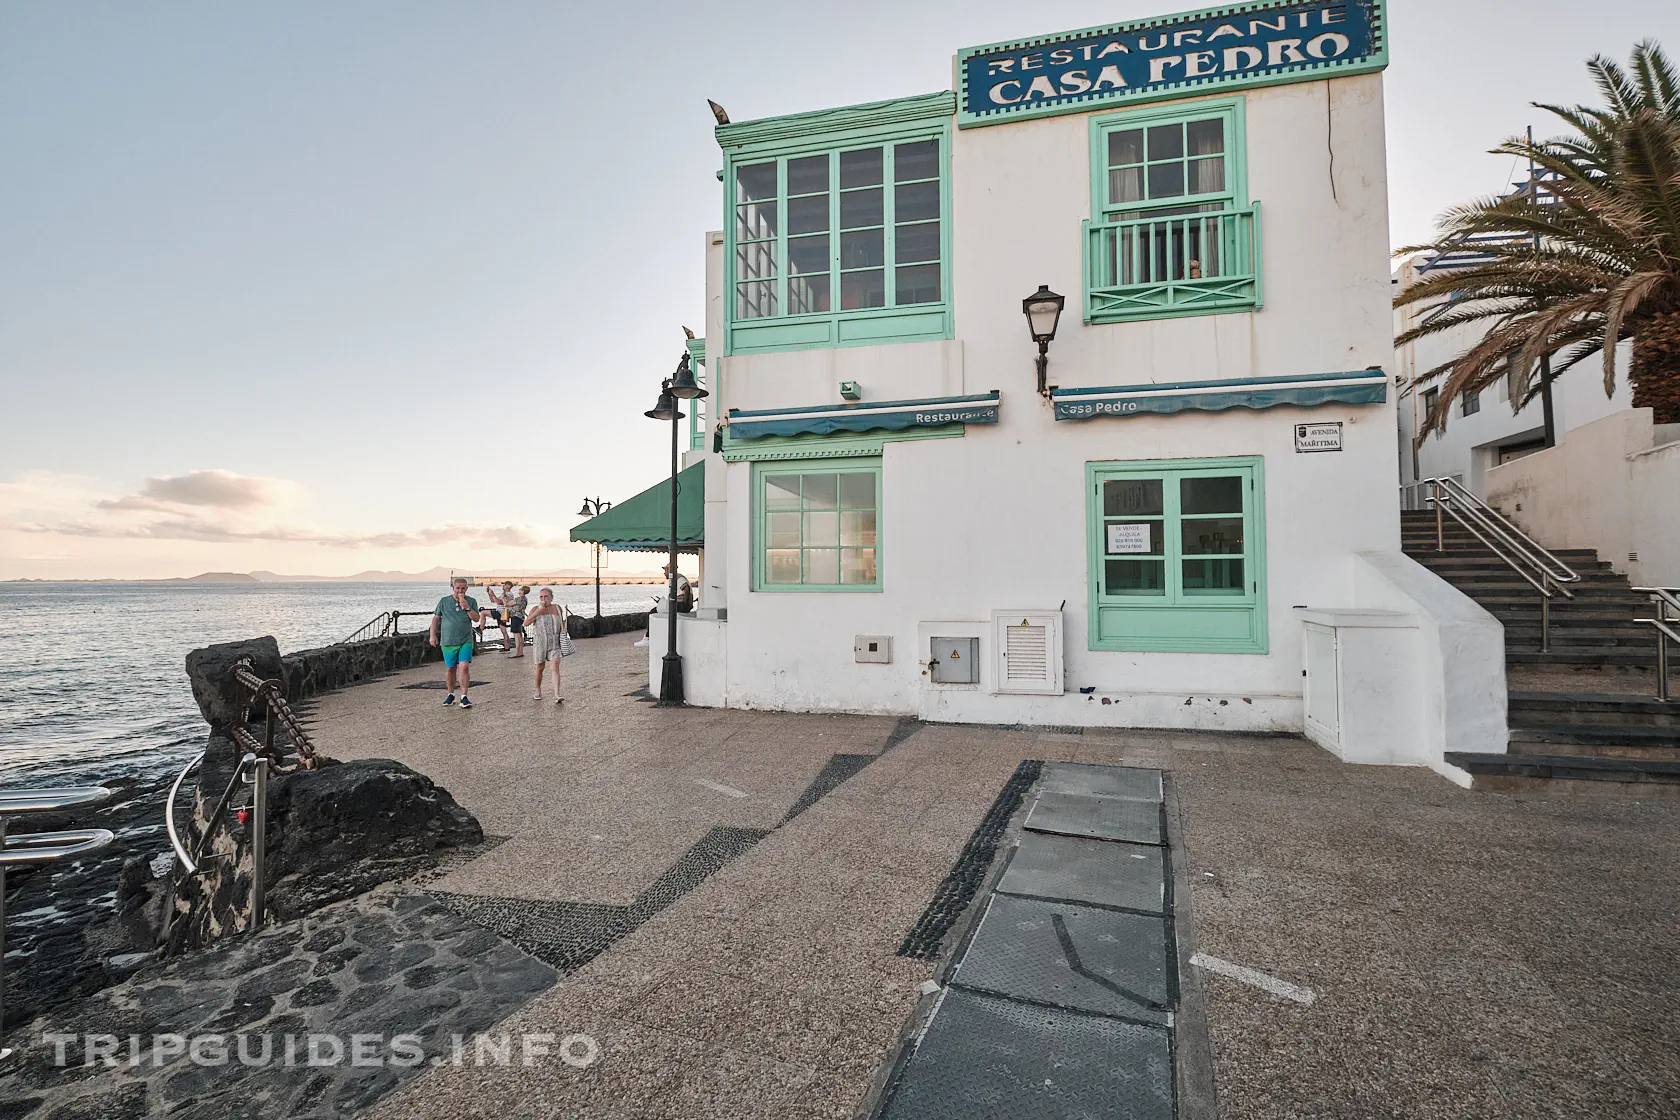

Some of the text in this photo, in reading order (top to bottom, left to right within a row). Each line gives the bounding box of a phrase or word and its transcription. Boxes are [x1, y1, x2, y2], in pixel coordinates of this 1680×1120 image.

[988, 6, 1347, 76] RESTAURANTE
[988, 32, 1350, 105] CASA PEDRO
[915, 409, 994, 423] Restaurae
[1095, 401, 1138, 413] Pedro
